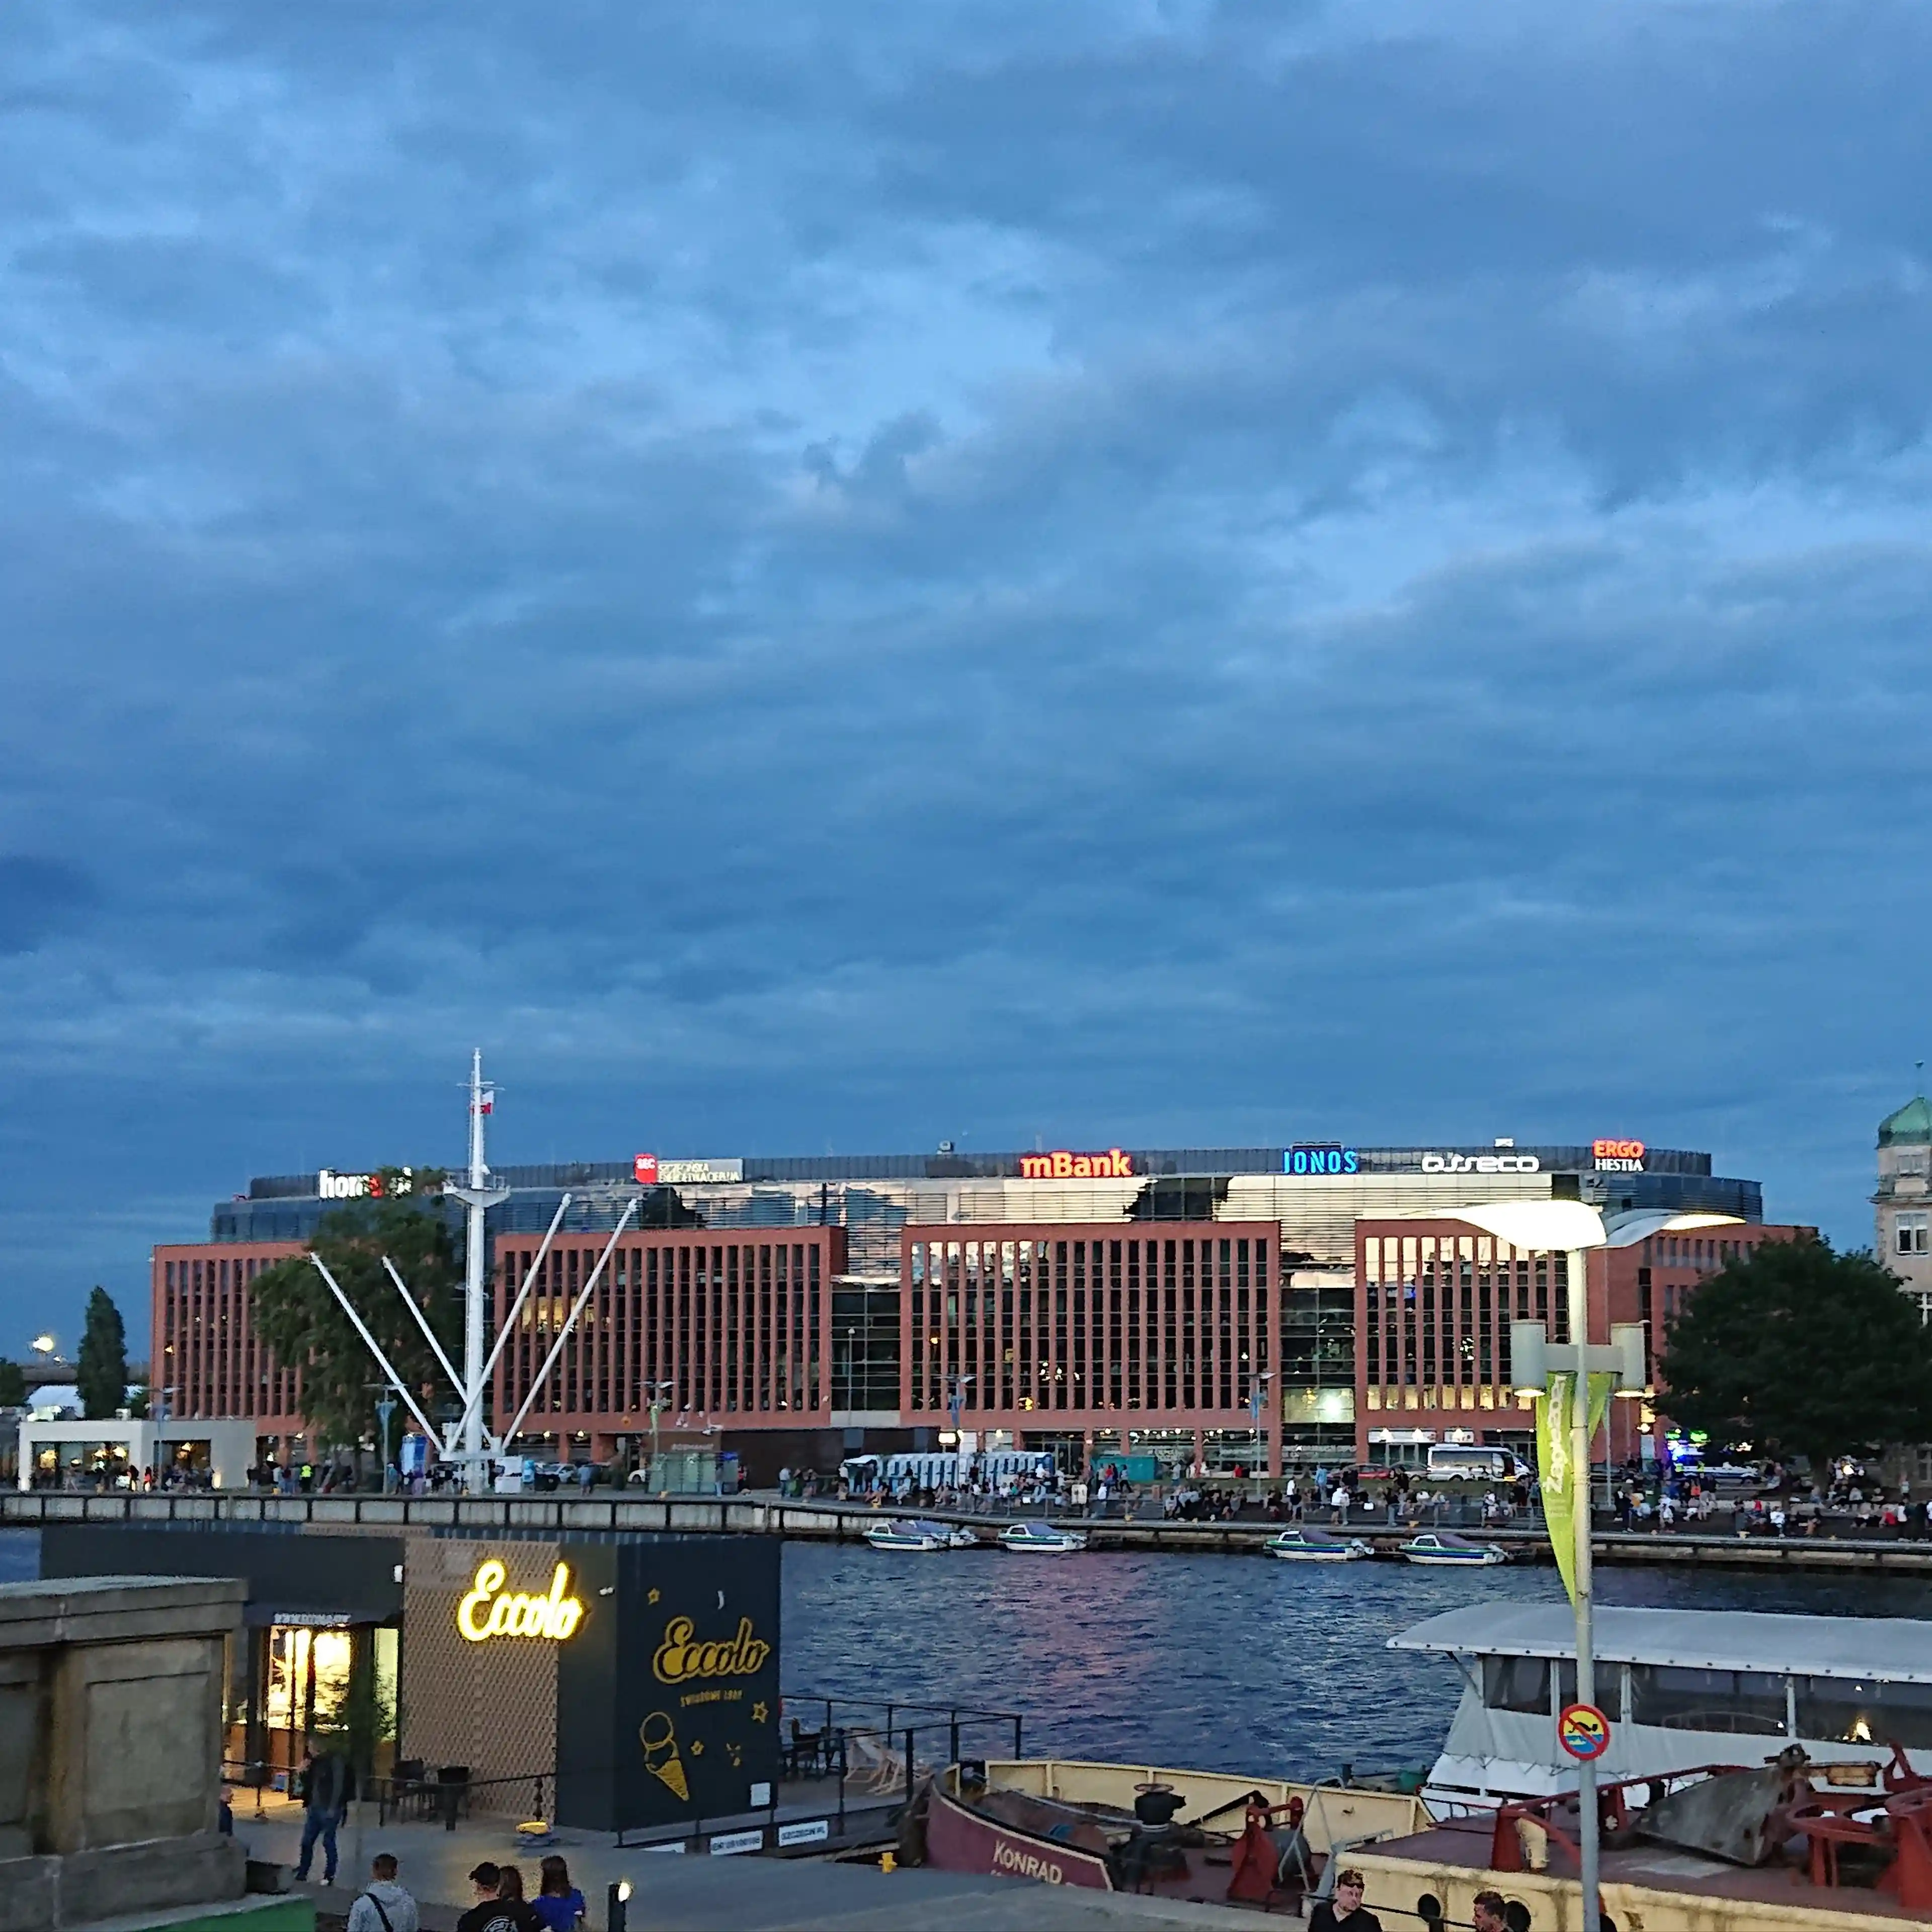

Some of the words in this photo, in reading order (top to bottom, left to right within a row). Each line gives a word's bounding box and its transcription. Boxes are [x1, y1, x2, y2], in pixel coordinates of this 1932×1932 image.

[1020, 1149, 1132, 1178] mBank
[1283, 1150, 1357, 1173] IONOS
[1593, 1141, 1644, 1158] ERGO
[1595, 1159, 1644, 1172] HESTIA
[457, 1559, 585, 1642] Eccolo
[653, 1616, 770, 1684] Eccolo
[992, 1839, 1063, 1885] KONRAD
